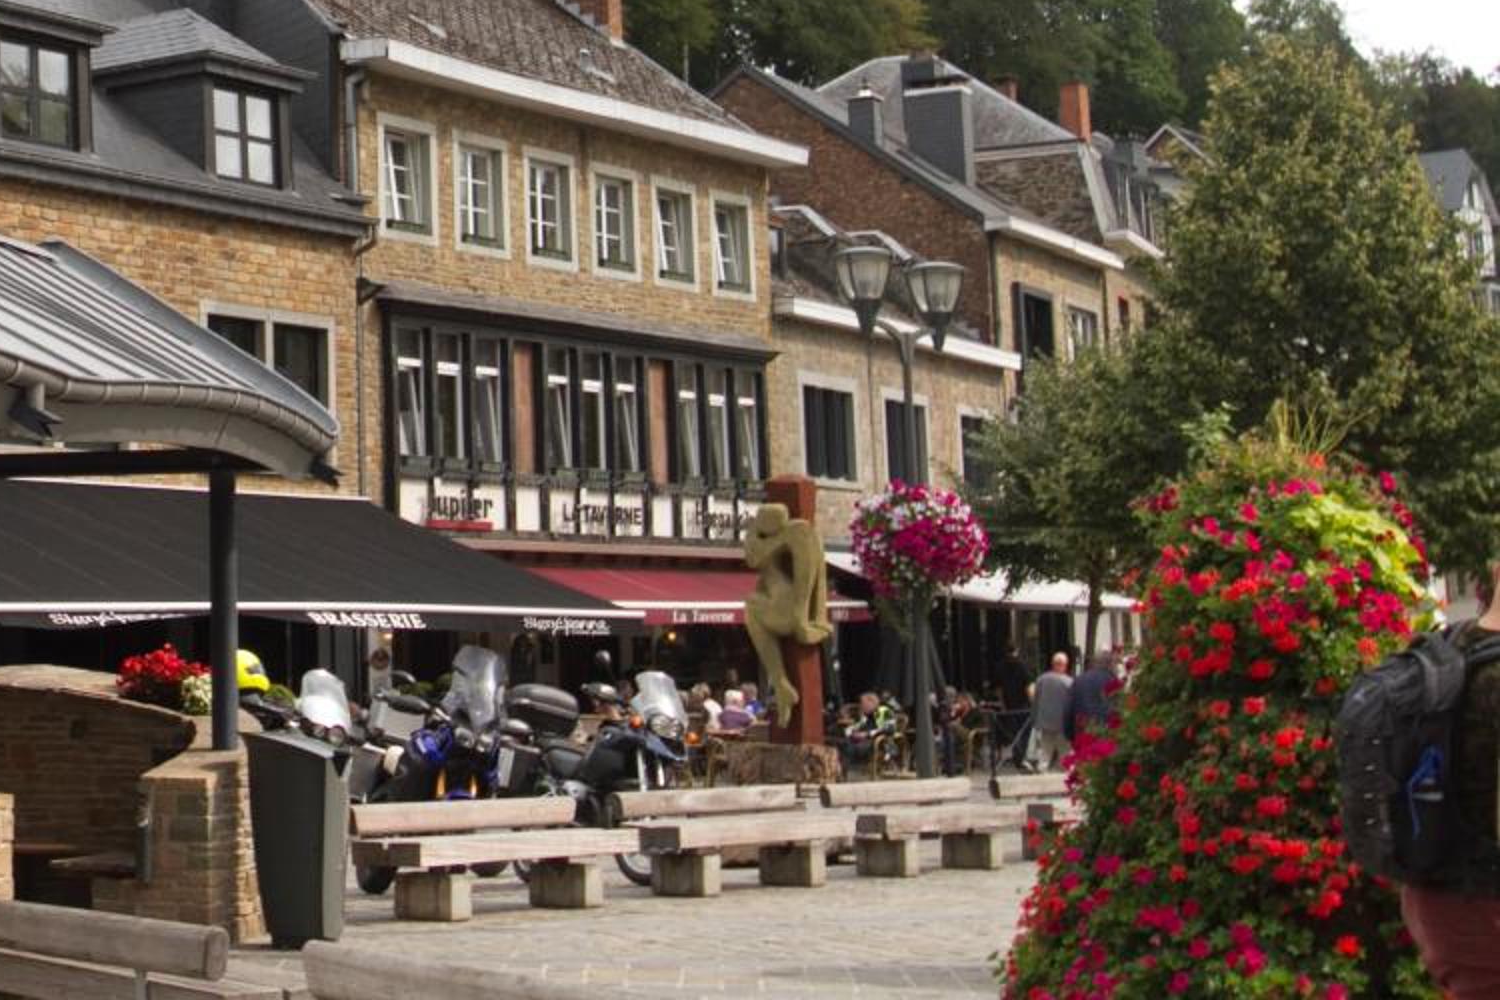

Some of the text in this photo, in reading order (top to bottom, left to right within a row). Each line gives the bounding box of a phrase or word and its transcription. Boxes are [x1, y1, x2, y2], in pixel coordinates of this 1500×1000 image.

[580, 503, 643, 526] TAVRNE
[307, 611, 427, 629] BRASSERIE
[673, 609, 735, 624] La Taverne
